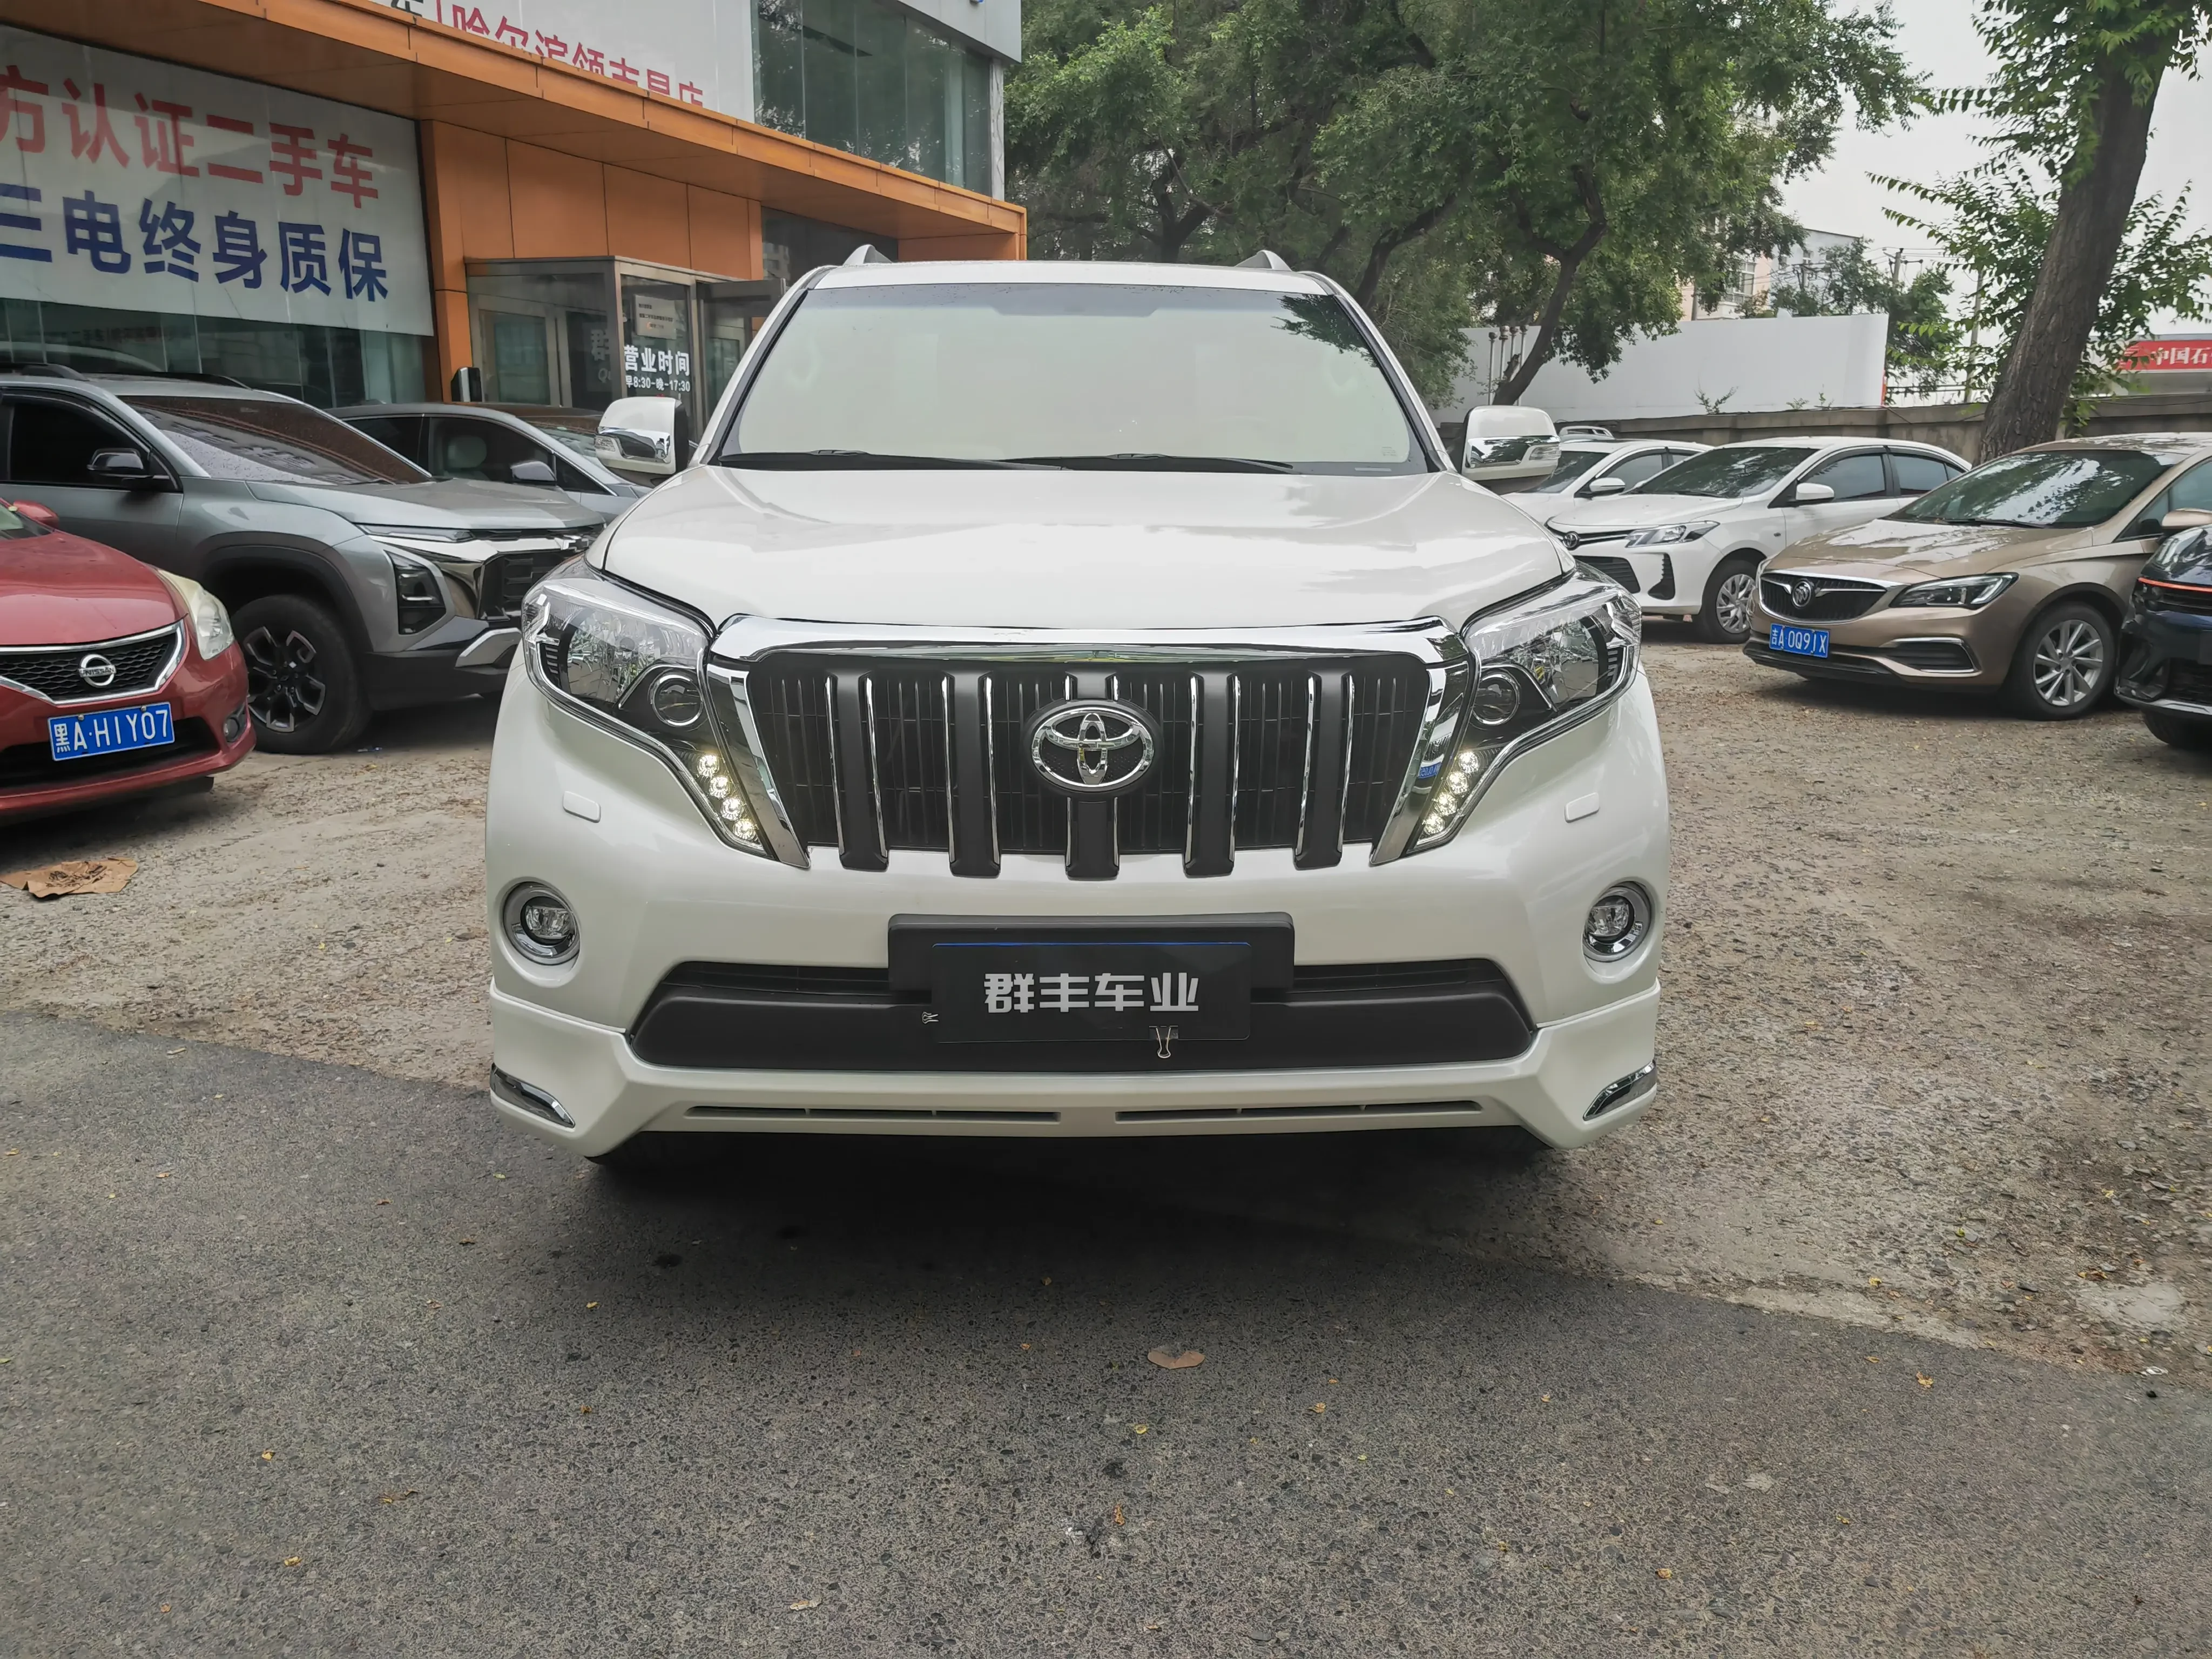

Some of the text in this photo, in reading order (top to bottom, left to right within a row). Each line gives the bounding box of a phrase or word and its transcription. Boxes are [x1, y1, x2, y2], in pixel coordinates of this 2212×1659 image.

[0, 65, 379, 208] 方认证二手车
[0, 183, 388, 302] 三电终身质保
[624, 344, 690, 376] 营业时间
[2150, 347, 2212, 365] 中国石
[85, 666, 114, 676] NISSAN
[983, 972, 1199, 1014] 群丰车业
